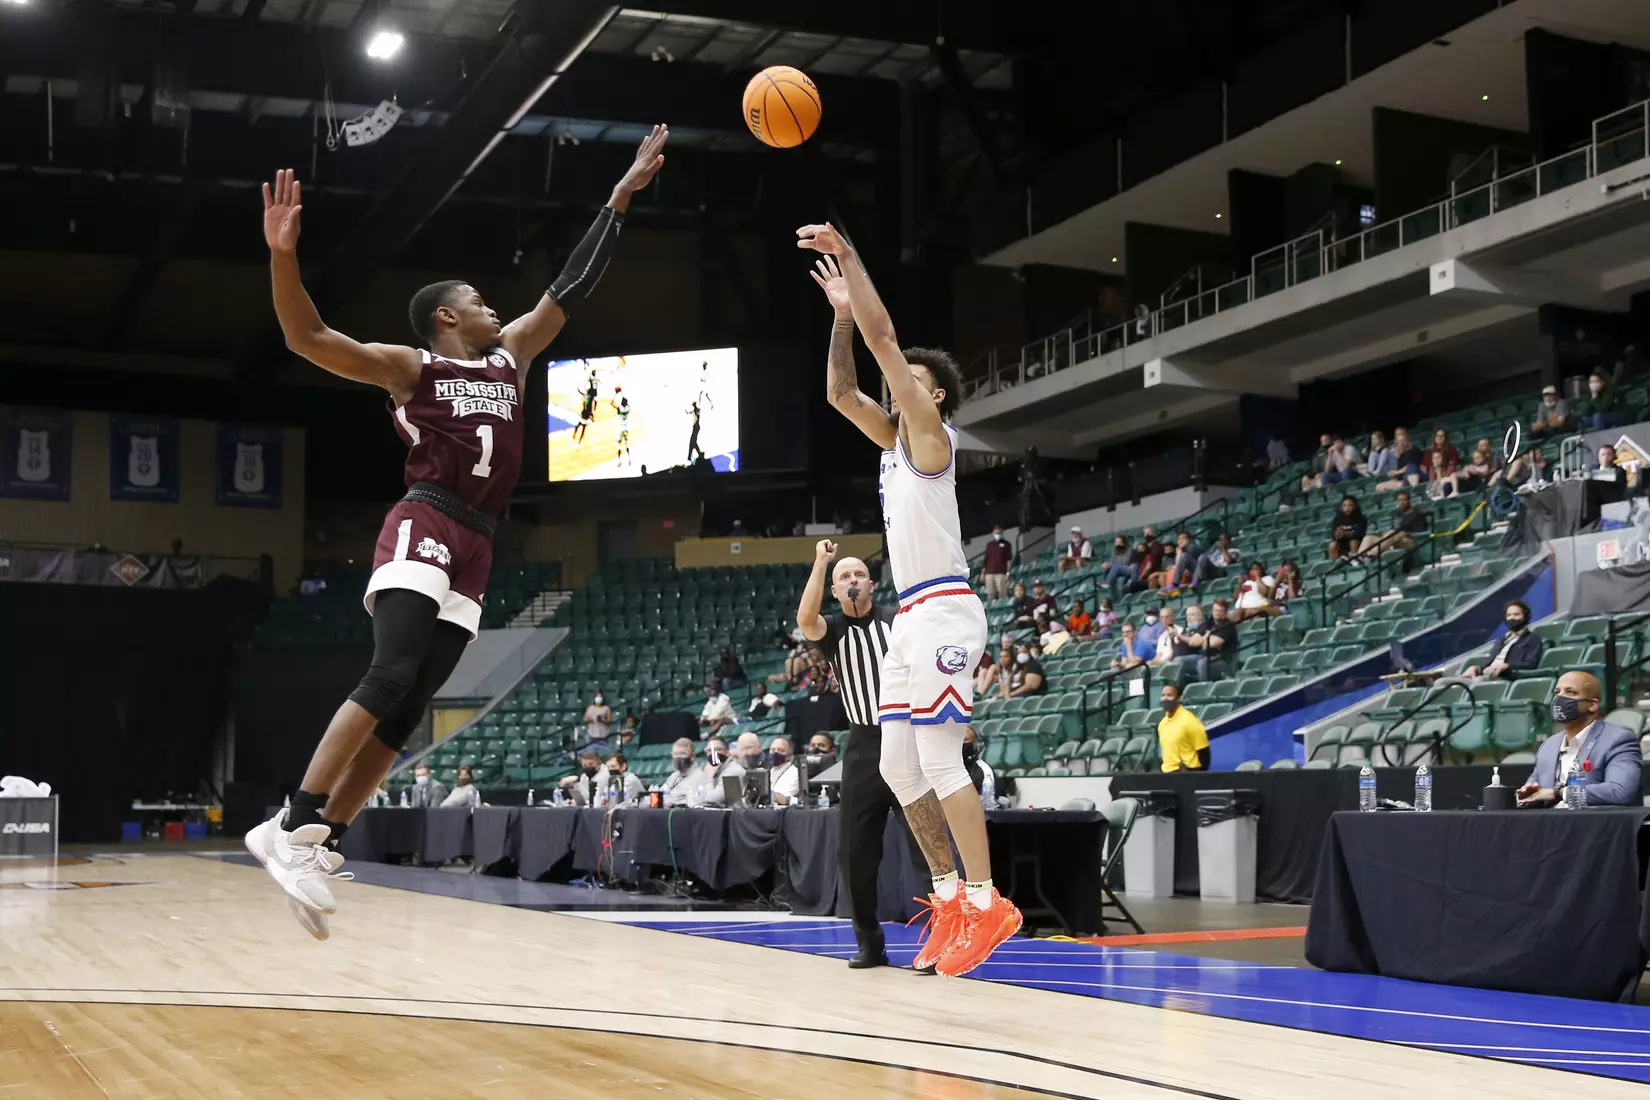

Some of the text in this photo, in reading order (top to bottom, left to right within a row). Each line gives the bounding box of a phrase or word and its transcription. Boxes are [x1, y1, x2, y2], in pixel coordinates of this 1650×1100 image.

[435, 382, 518, 402] MISSISSIPPI
[464, 400, 504, 415] STATE
[471, 425, 493, 478] 1
